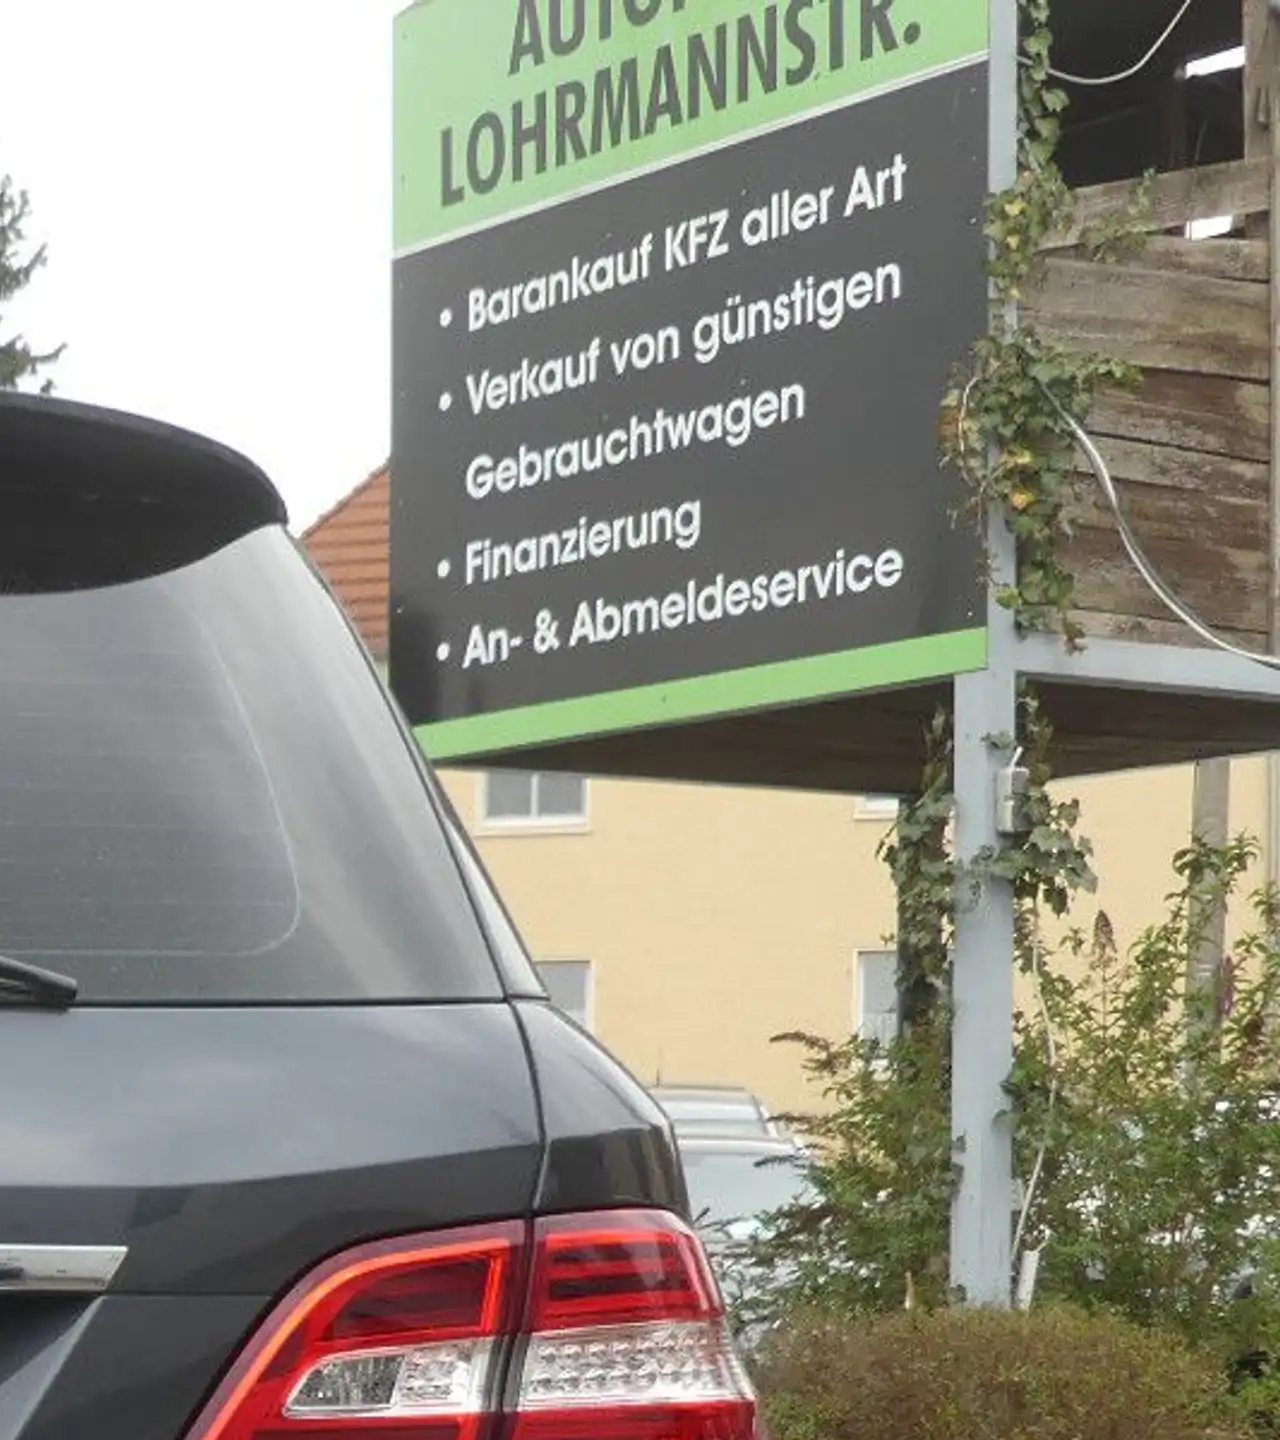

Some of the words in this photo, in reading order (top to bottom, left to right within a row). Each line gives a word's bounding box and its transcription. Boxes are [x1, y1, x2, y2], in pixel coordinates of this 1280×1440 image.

[440, 0, 922, 207] LOHRMANNSTR.
[468, 232, 653, 332] Barankauf
[664, 207, 730, 272] KFZ
[740, 184, 835, 247] aller
[842, 152, 908, 218] Art
[466, 336, 600, 415] Verkauf
[609, 324, 680, 377] von
[692, 262, 902, 364] günstigen
[465, 382, 805, 500] Gebrauchtwagen
[461, 624, 522, 669] An-
[533, 608, 560, 655] &
[568, 547, 904, 647] Abmeldeservice
[465, 500, 702, 585] Finanzierung
